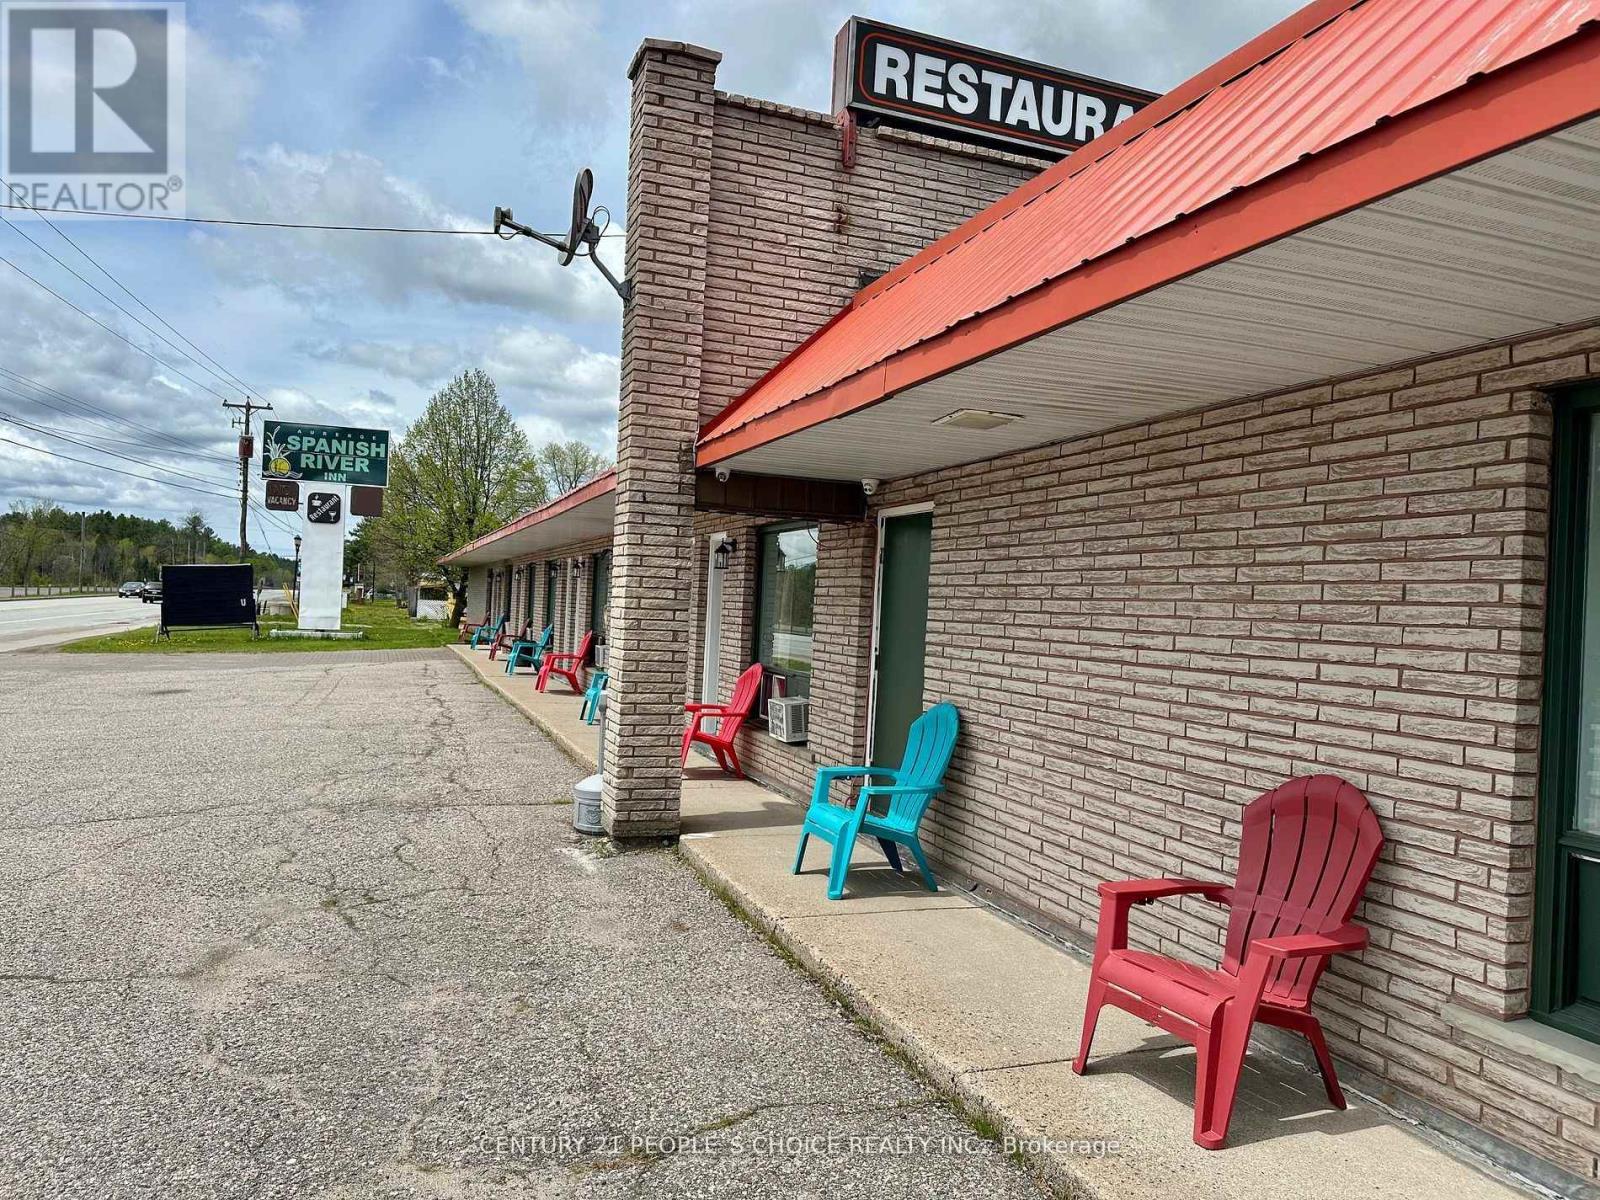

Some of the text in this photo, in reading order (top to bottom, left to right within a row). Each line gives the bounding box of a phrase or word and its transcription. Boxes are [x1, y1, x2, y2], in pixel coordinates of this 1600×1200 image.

[287, 435, 386, 458] SPANISH
[300, 453, 370, 473] RIVER
[324, 471, 347, 482] INN
[267, 495, 297, 505] VACANCY
[309, 495, 340, 521] Restaurant
